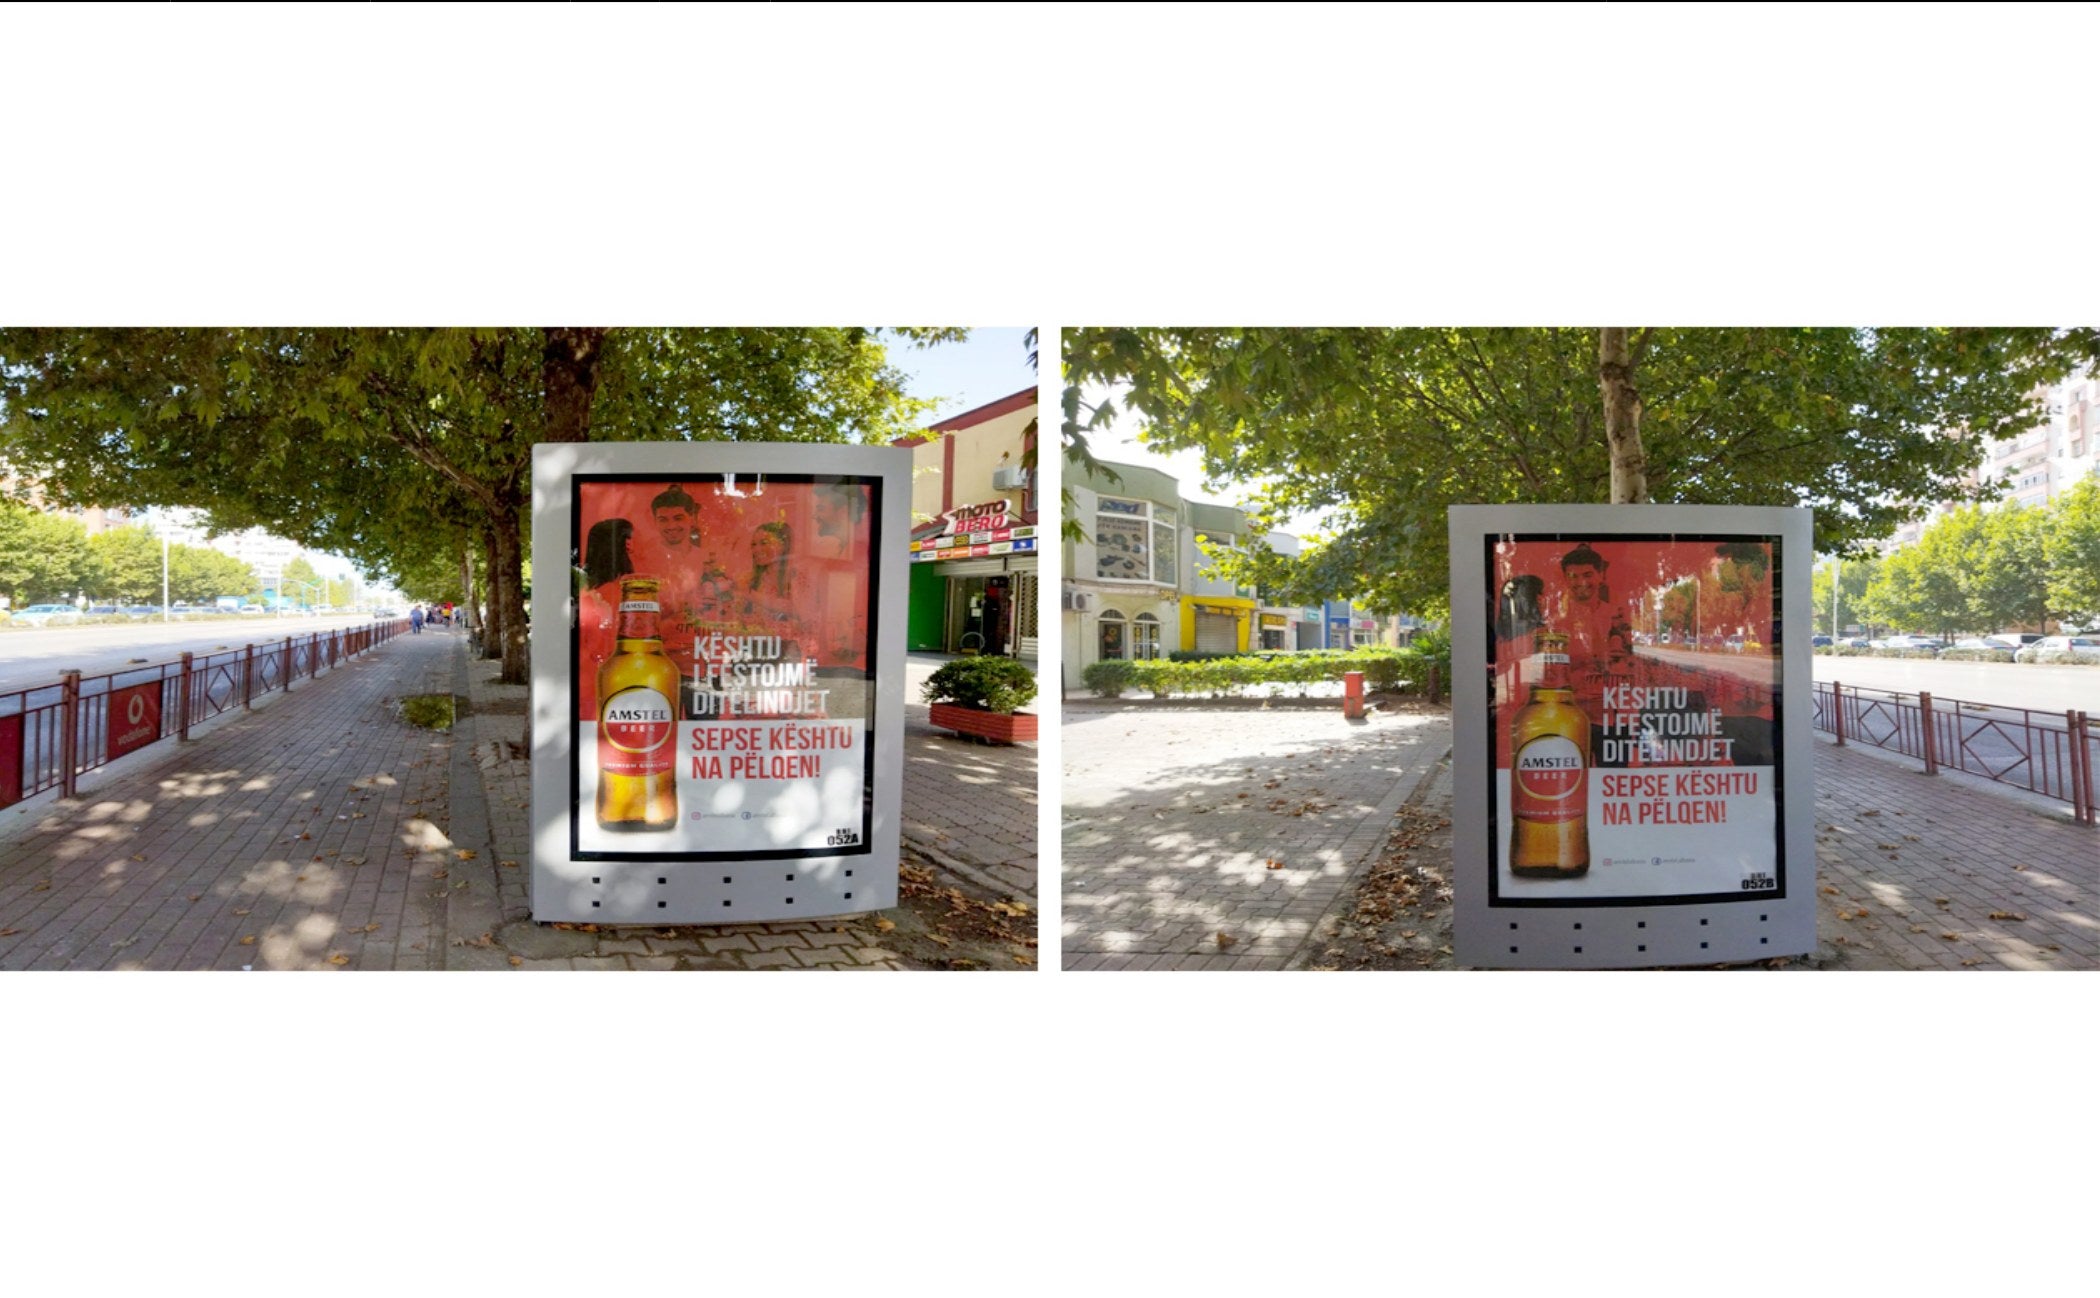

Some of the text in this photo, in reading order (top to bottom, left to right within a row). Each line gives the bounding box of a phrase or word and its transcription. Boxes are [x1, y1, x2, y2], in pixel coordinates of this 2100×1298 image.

[954, 514, 1005, 533] BERO
[957, 500, 1007, 520] MOTO
[693, 632, 782, 660] KËSHTU
[693, 658, 818, 687] I FESTOJMË
[692, 688, 830, 715] DITËLINDJET
[1602, 683, 1688, 709] KËSHTU
[608, 709, 667, 720] AMSTEL
[1602, 708, 1723, 736] I FESTOJMË
[691, 723, 852, 751] SEPSE KËSHTU
[1602, 736, 1735, 763] DITËLINDJET
[692, 752, 820, 780] NA PËLQEN!
[1521, 757, 1578, 768] AMSTEL
[1602, 770, 1758, 797] SEPSE KËSHTU
[1602, 798, 1726, 825] NA PËLQEN!
[827, 834, 859, 846] 052A
[1741, 878, 1774, 890] 052B
